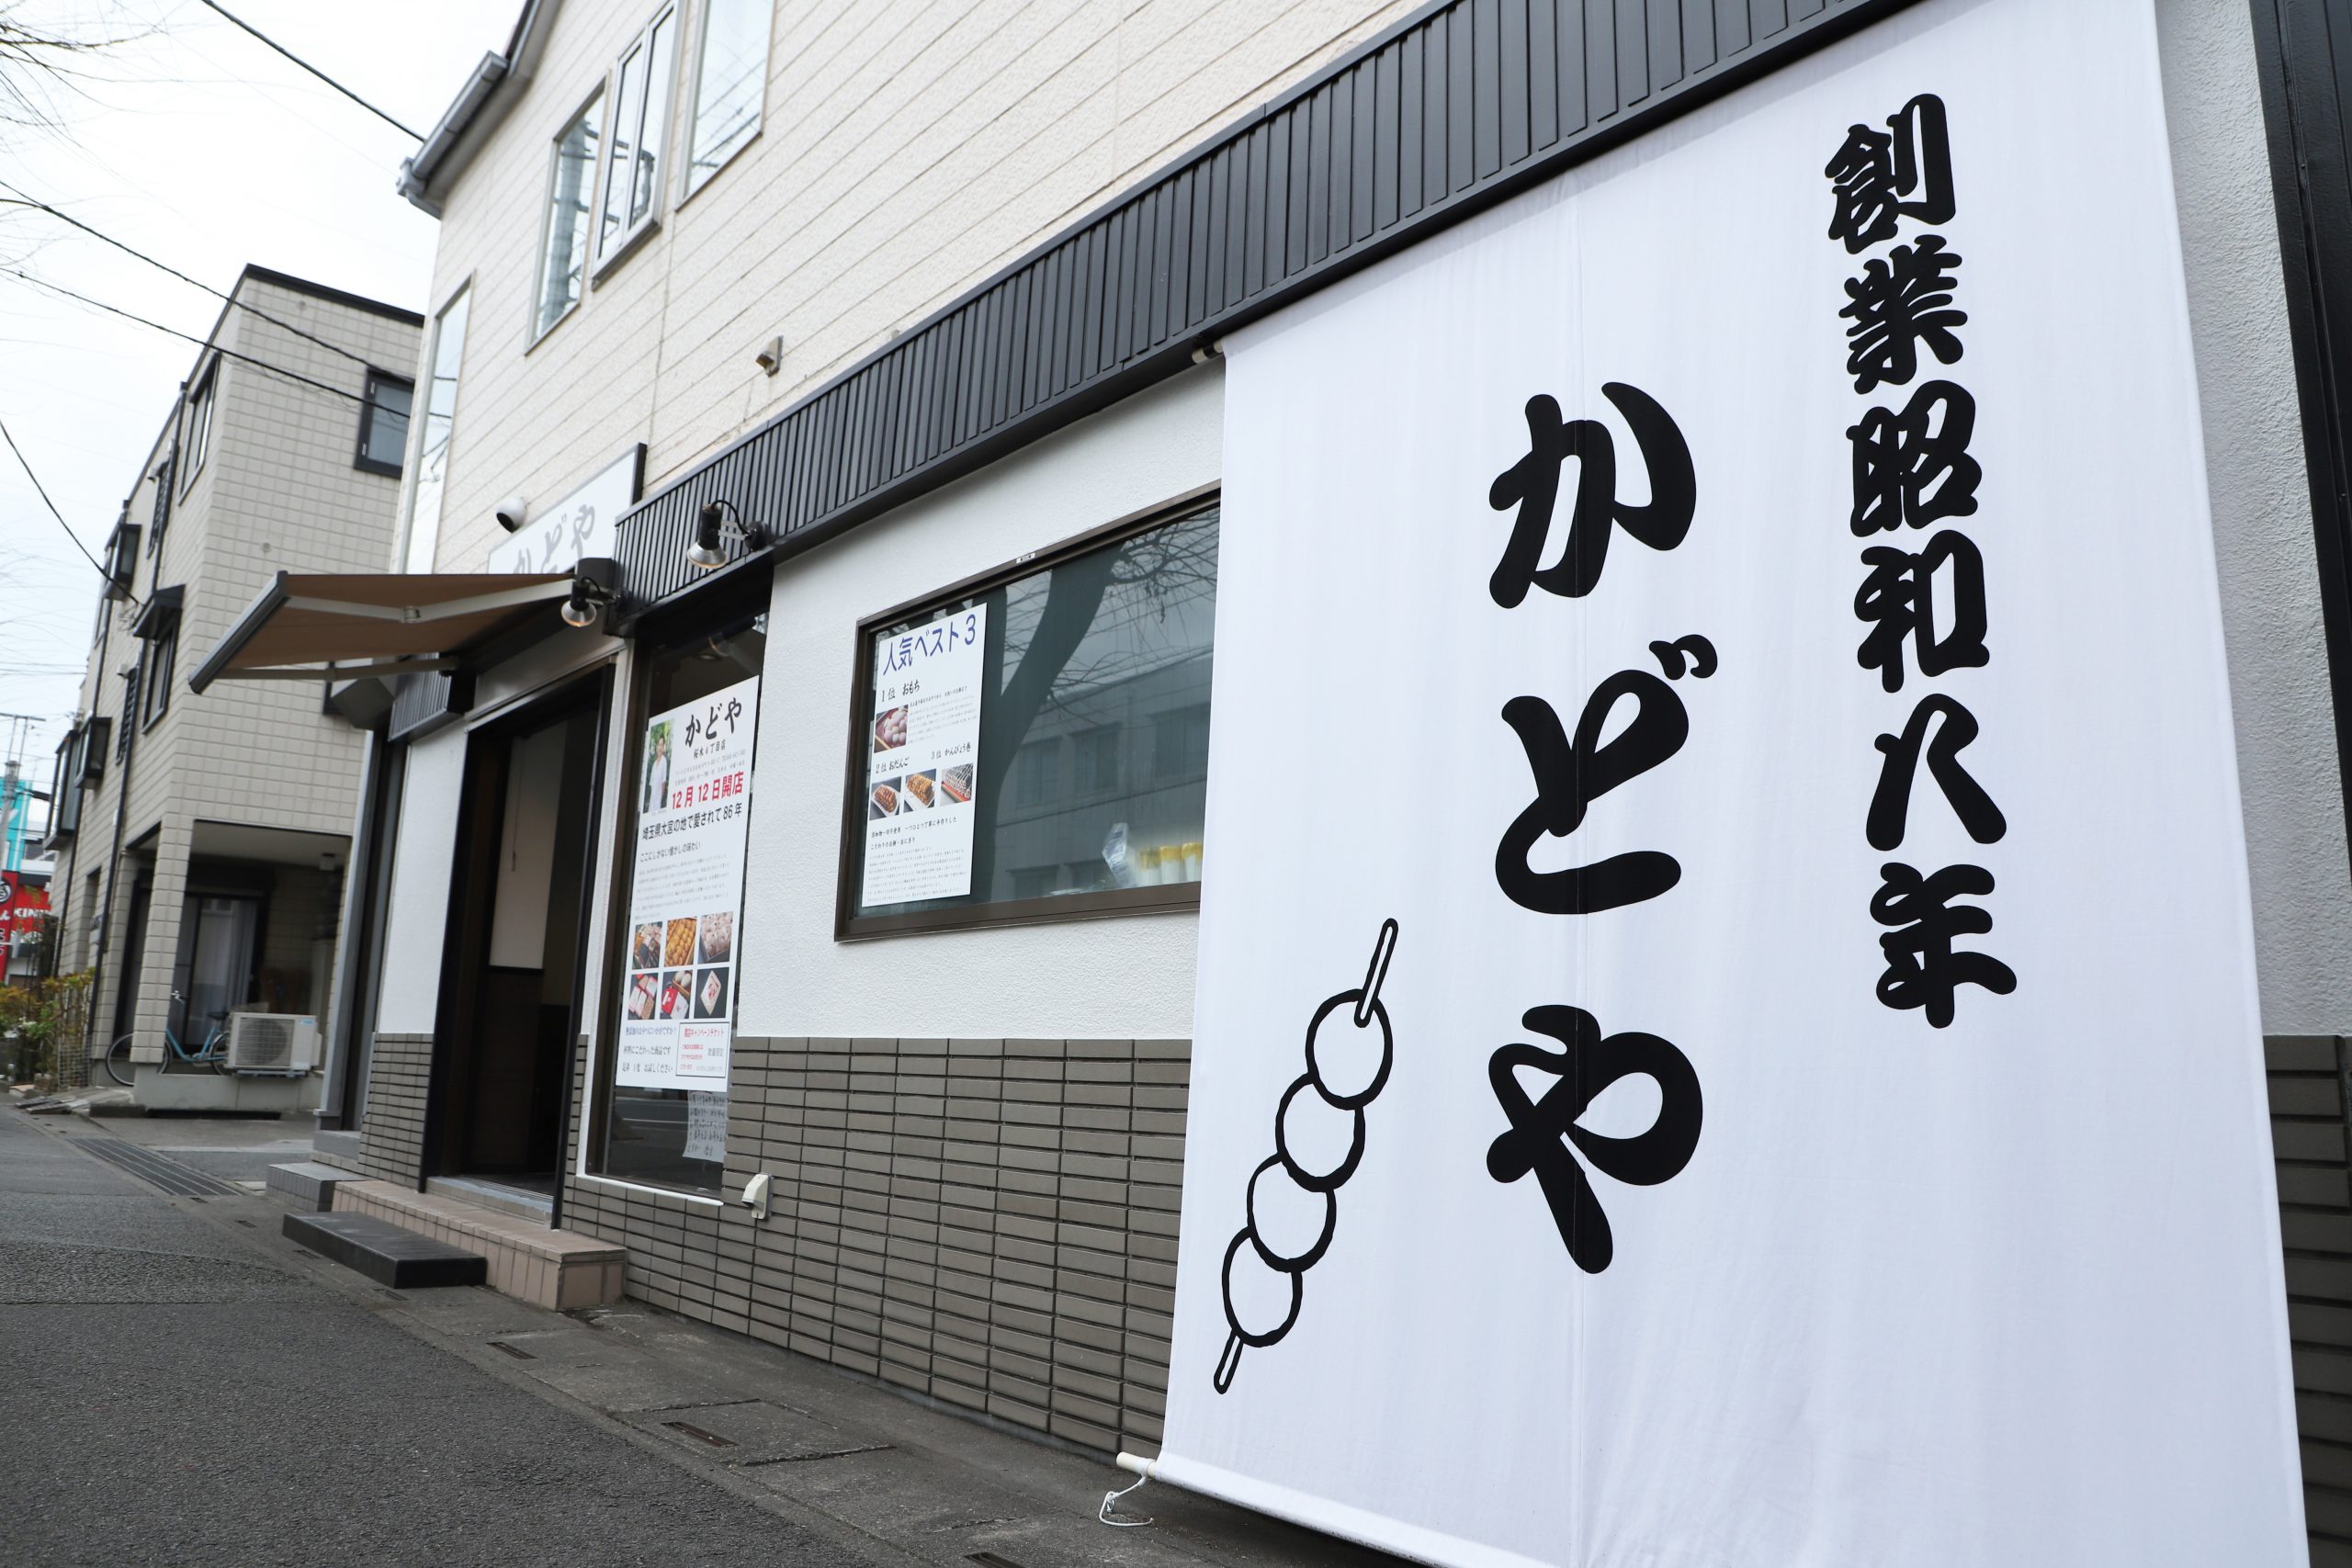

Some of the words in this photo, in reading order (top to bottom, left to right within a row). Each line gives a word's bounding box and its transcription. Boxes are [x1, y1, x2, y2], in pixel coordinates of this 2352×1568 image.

[684, 697, 742, 748] かどや
[902, 678, 921, 696] おもち
[1825, 94, 2017, 1029] 創業昭和八年
[1487, 382, 1717, 1274] かどや
